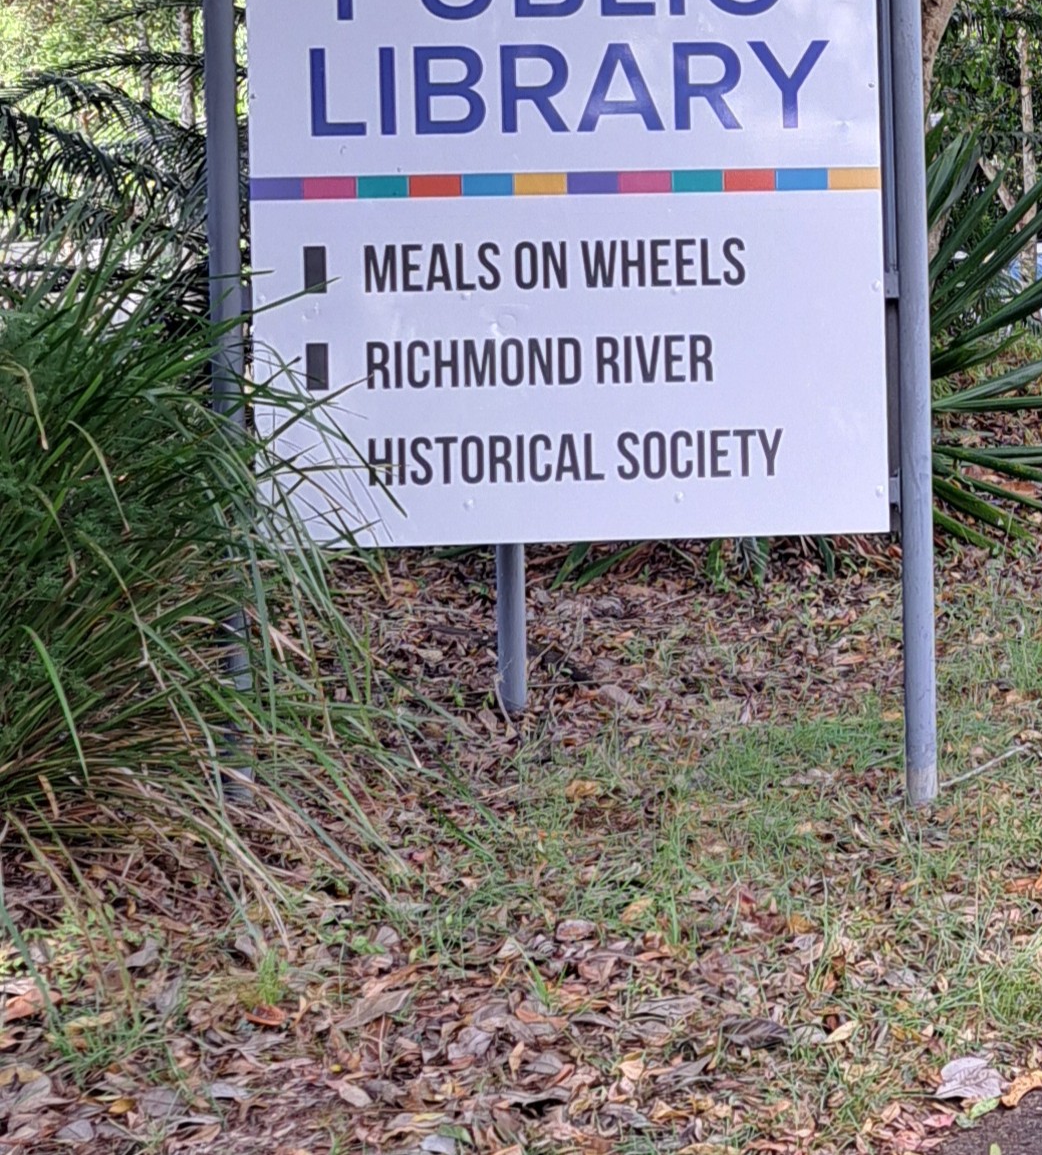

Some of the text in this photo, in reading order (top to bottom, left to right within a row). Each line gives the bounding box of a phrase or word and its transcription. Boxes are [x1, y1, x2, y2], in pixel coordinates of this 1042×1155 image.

[309, 39, 829, 136] LIBRARY
[363, 237, 747, 294] MEALS ON WHEELS
[365, 334, 714, 390] RICHMOND RIVER
[367, 427, 785, 487] HISTORICAL SOCIETY
